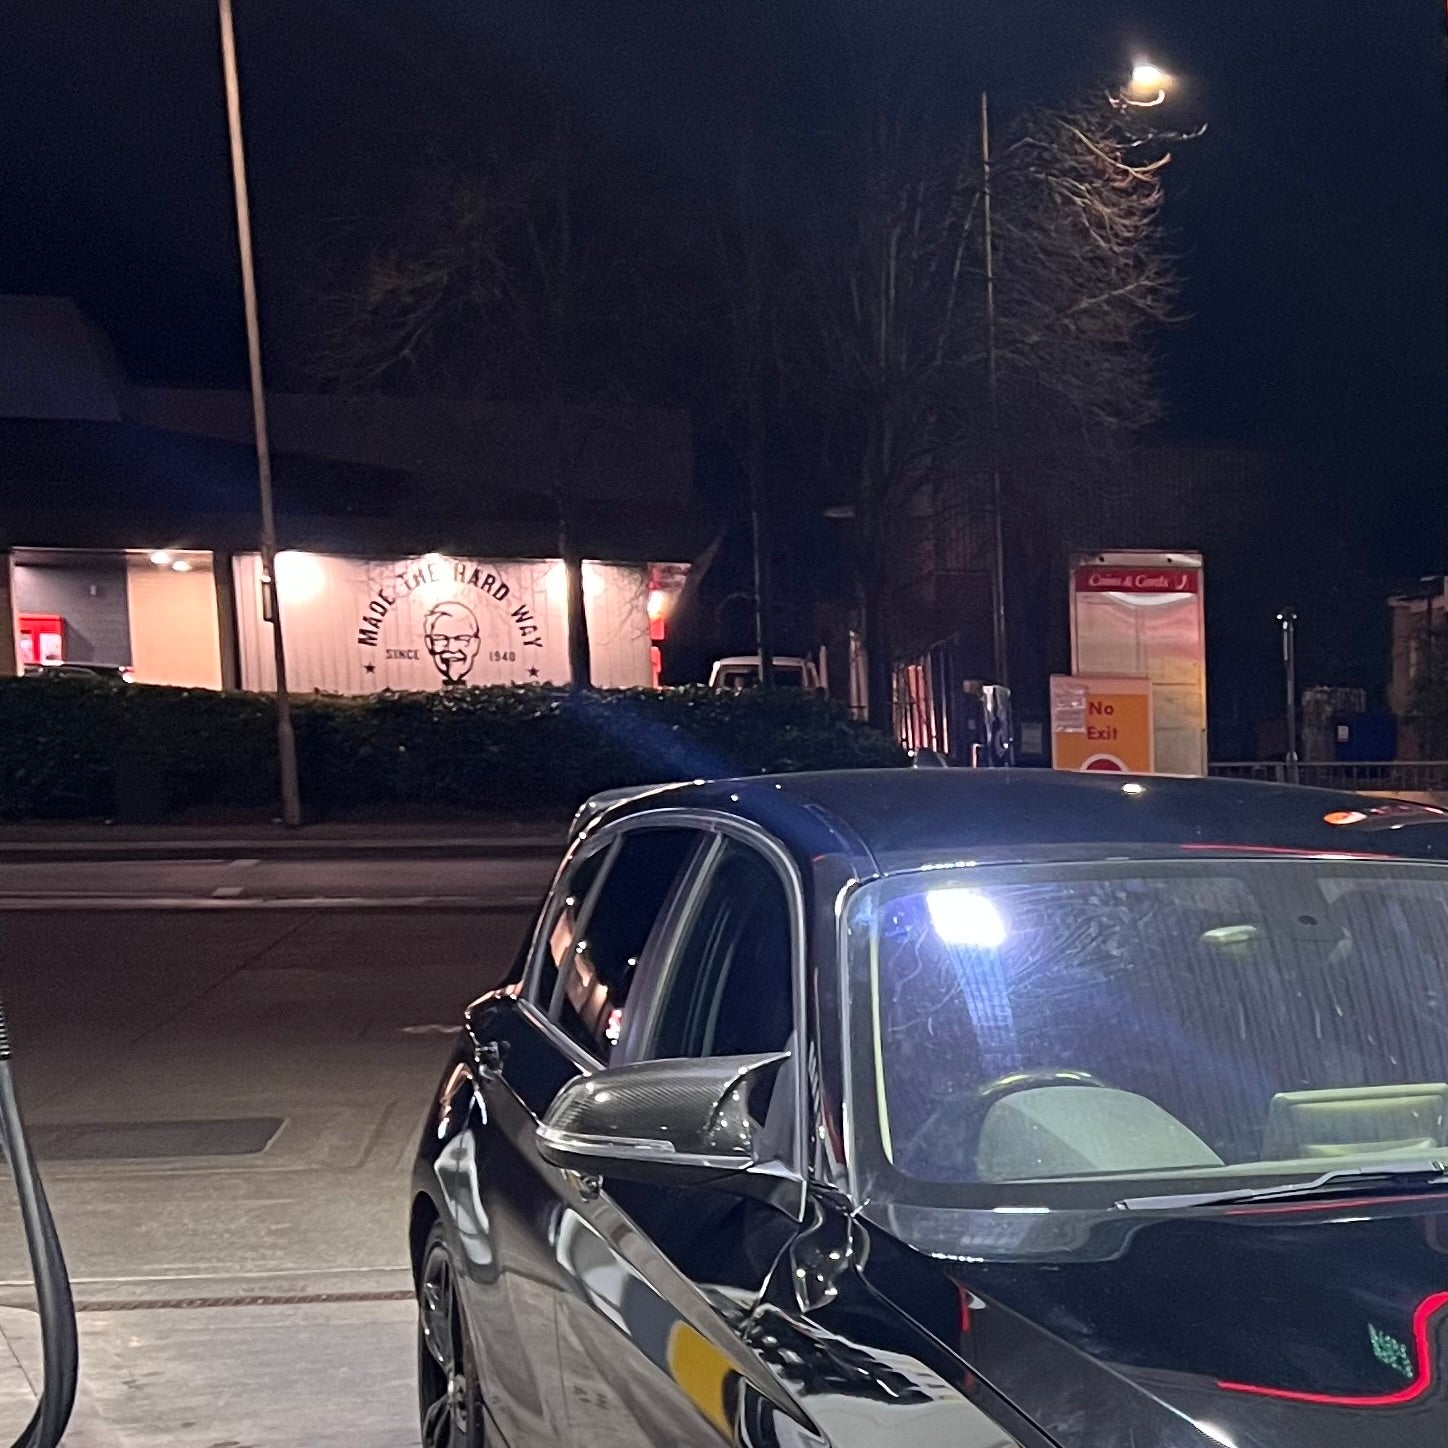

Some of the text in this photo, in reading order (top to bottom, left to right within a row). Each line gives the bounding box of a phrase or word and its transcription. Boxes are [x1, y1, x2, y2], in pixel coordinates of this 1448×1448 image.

[358, 589, 396, 647] MADE
[453, 563, 510, 601] HARD
[511, 604, 543, 648] WAY
[386, 648, 420, 661] SINCE
[489, 651, 516, 662] 1940
[1089, 701, 1114, 716] No
[1087, 726, 1117, 740] Exit
